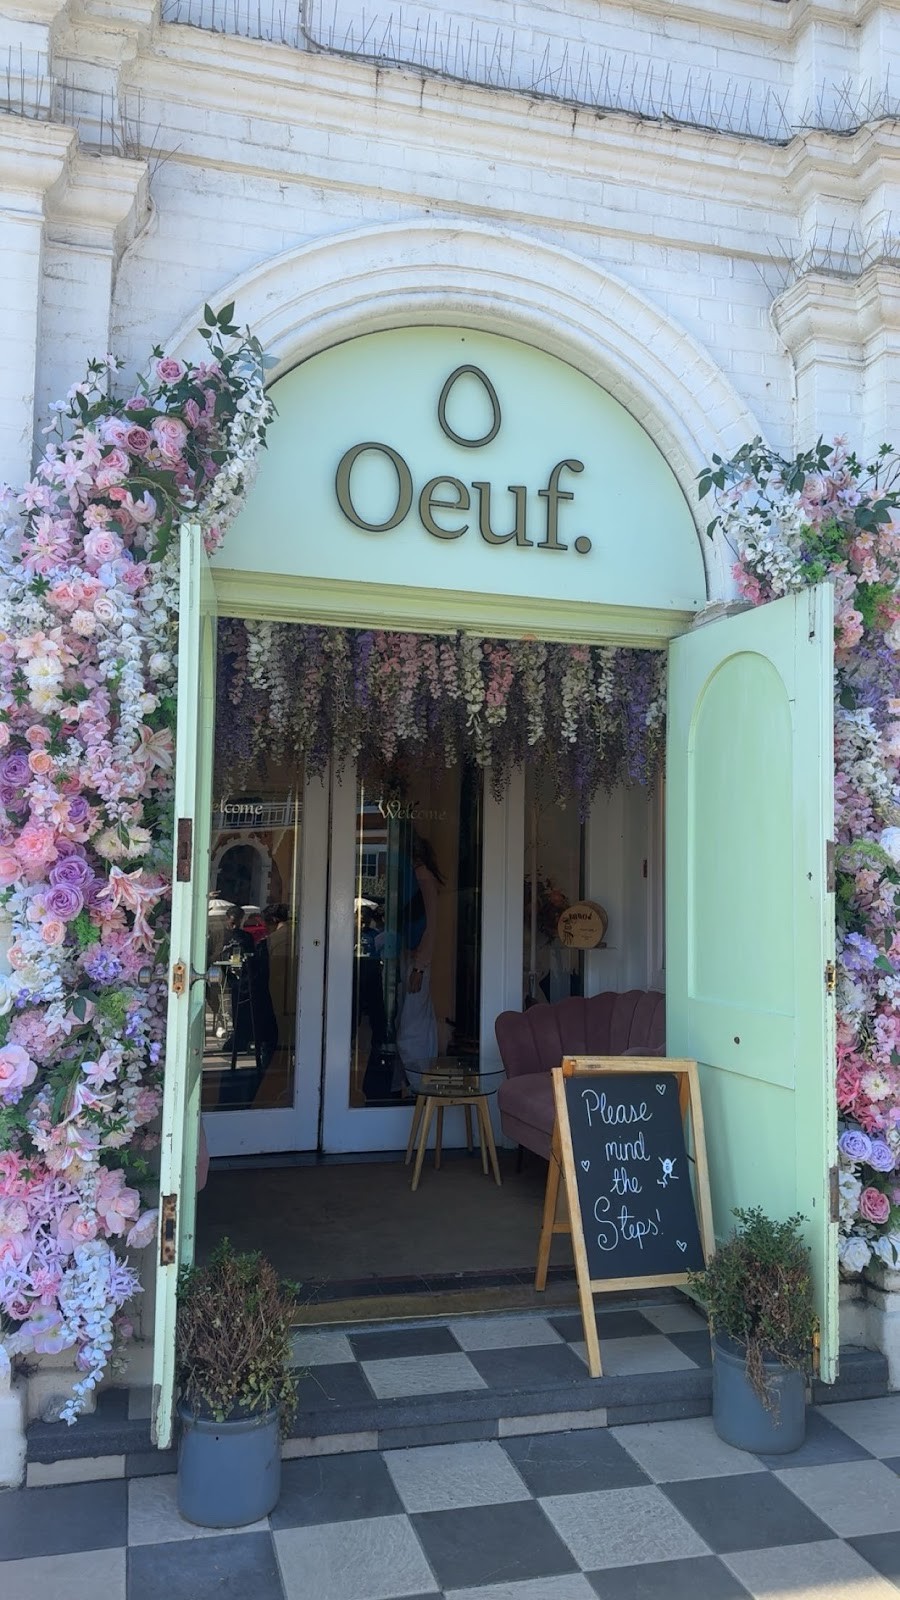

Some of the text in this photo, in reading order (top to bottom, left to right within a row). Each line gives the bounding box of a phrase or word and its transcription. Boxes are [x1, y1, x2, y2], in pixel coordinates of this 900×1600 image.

[335, 441, 592, 555] Oeuf.
[210, 796, 263, 815] elcome
[375, 799, 448, 820] Welcome
[581, 1089, 653, 1127] Please
[604, 1131, 651, 1162] mind
[609, 1166, 643, 1196] the
[594, 1196, 664, 1251] Steps!
